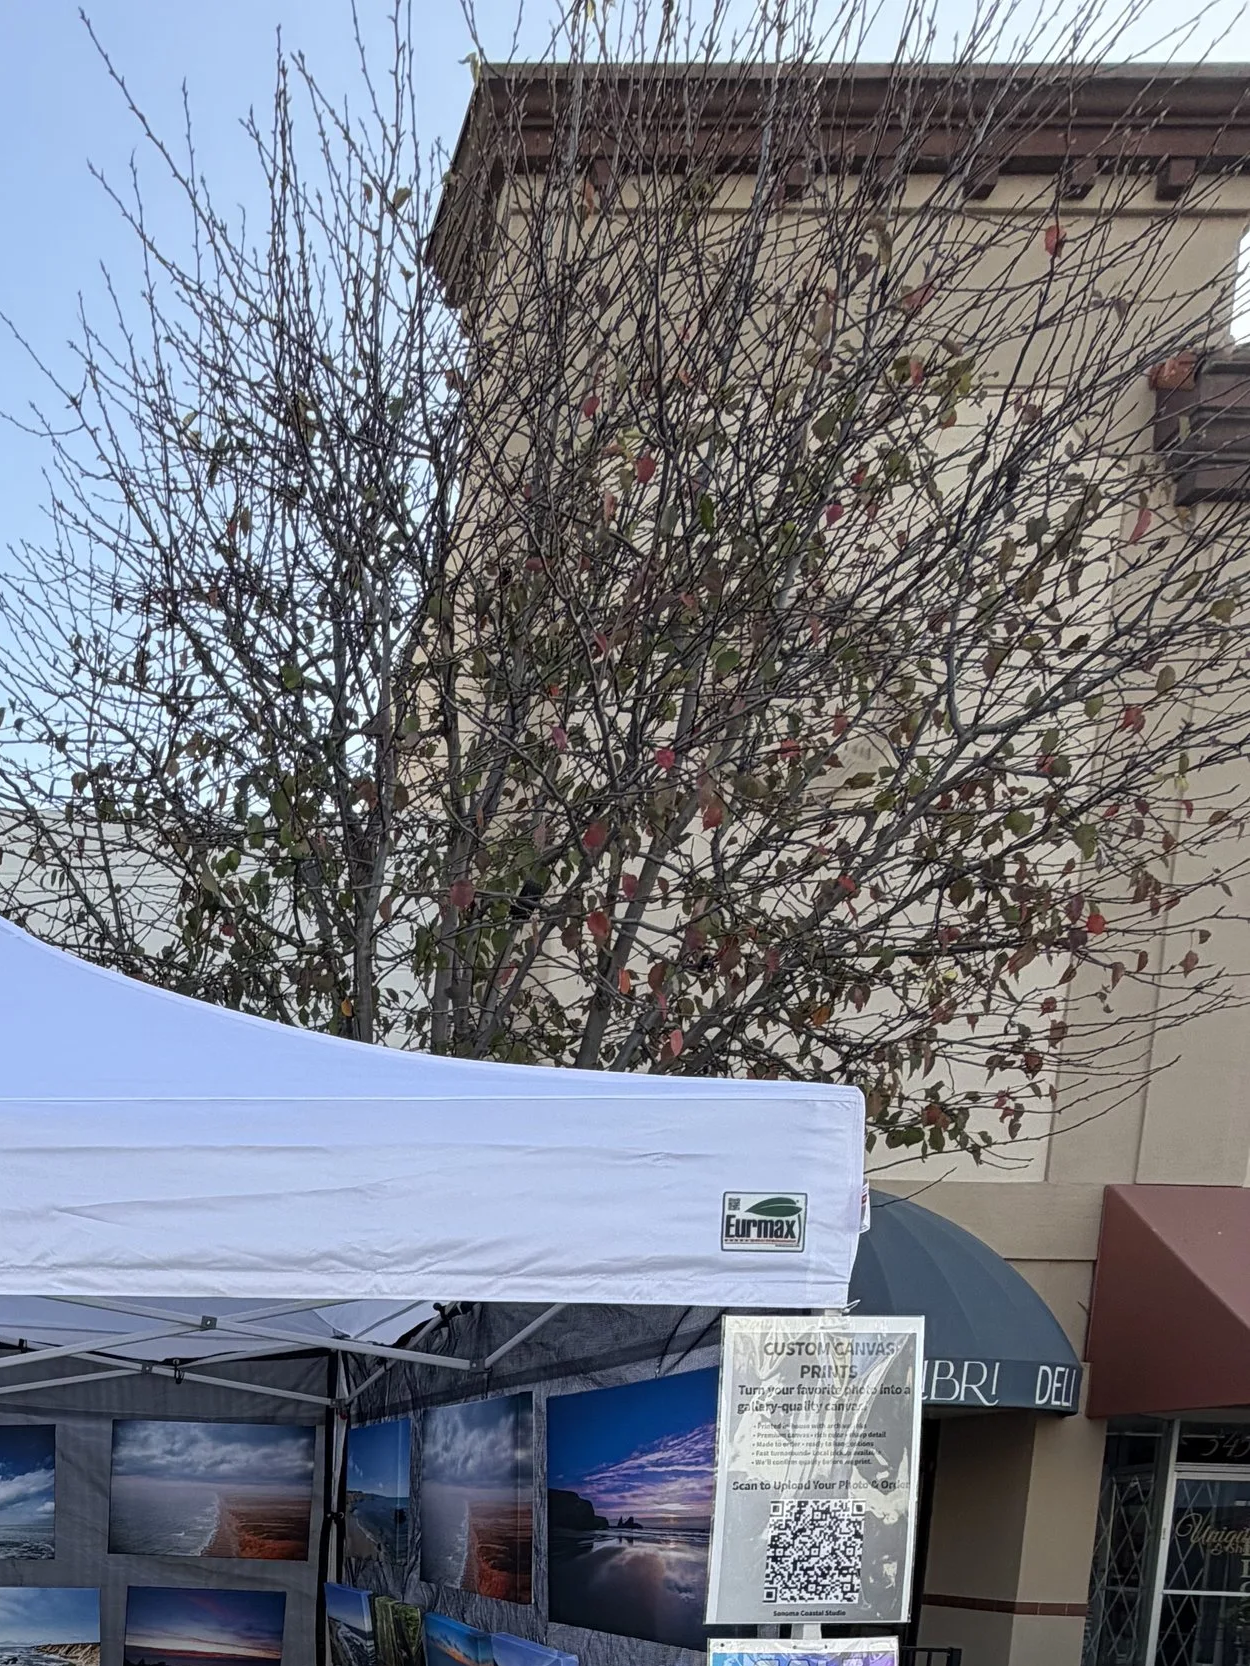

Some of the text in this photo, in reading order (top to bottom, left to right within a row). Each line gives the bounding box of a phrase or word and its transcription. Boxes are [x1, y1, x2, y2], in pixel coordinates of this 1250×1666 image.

[724, 1214, 796, 1239] Eurmax
[764, 1342, 896, 1356] CUSTOM CANVAS
[800, 1365, 858, 1379] PRINTS
[922, 1360, 1076, 1407] IBRI DELI
[738, 1384, 765, 1395] Turn
[767, 1386, 794, 1398] your
[797, 1384, 840, 1395] favorite
[880, 1384, 903, 1395] into
[732, 1480, 758, 1490] Scan
[760, 1481, 770, 1490] to
[773, 1480, 810, 1493] Upload
[813, 1480, 835, 1490] Your
[773, 1609, 846, 1617] Sonoma Coastal Studio
